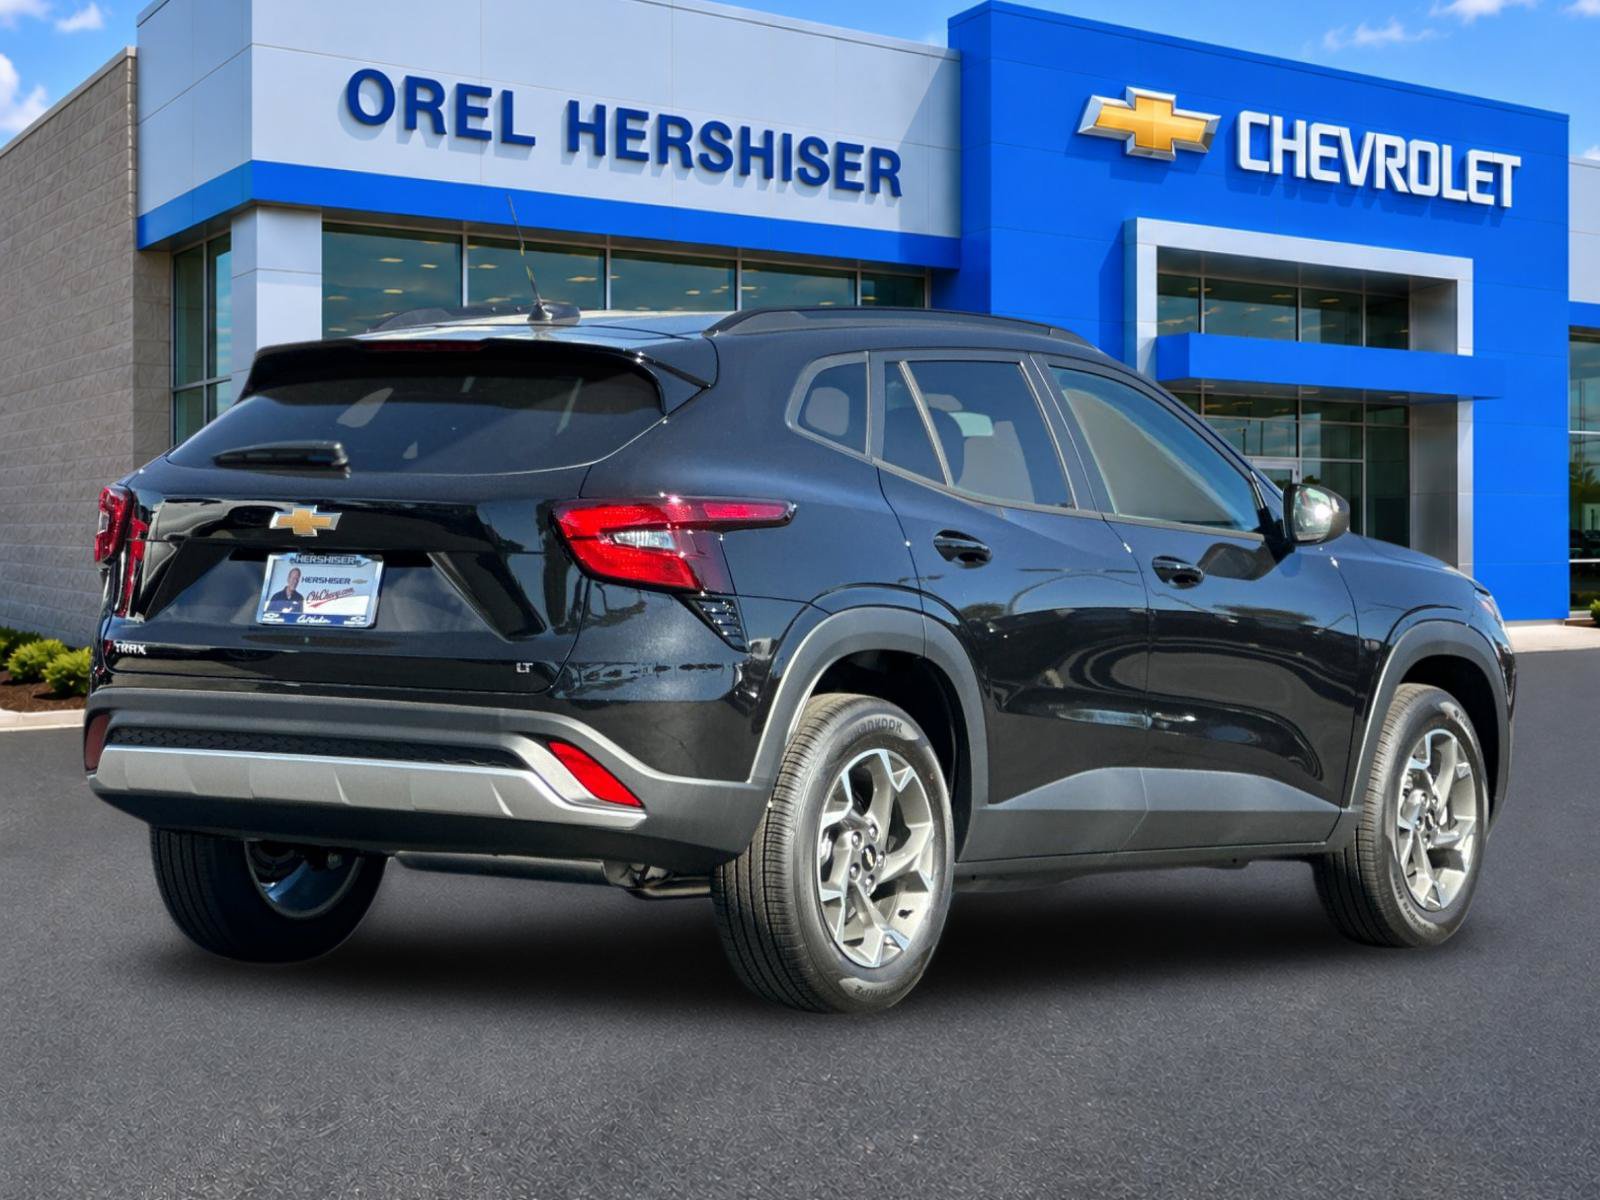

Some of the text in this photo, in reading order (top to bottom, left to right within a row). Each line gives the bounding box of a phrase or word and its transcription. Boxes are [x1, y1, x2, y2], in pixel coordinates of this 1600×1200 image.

[346, 68, 902, 197] OREL HERSHISER
[1236, 109, 1521, 208] CHEVROLET
[295, 554, 356, 565] HERSHISER
[301, 576, 352, 585] HERSHISER
[115, 643, 147, 655] TRAX
[516, 662, 534, 673] LT
